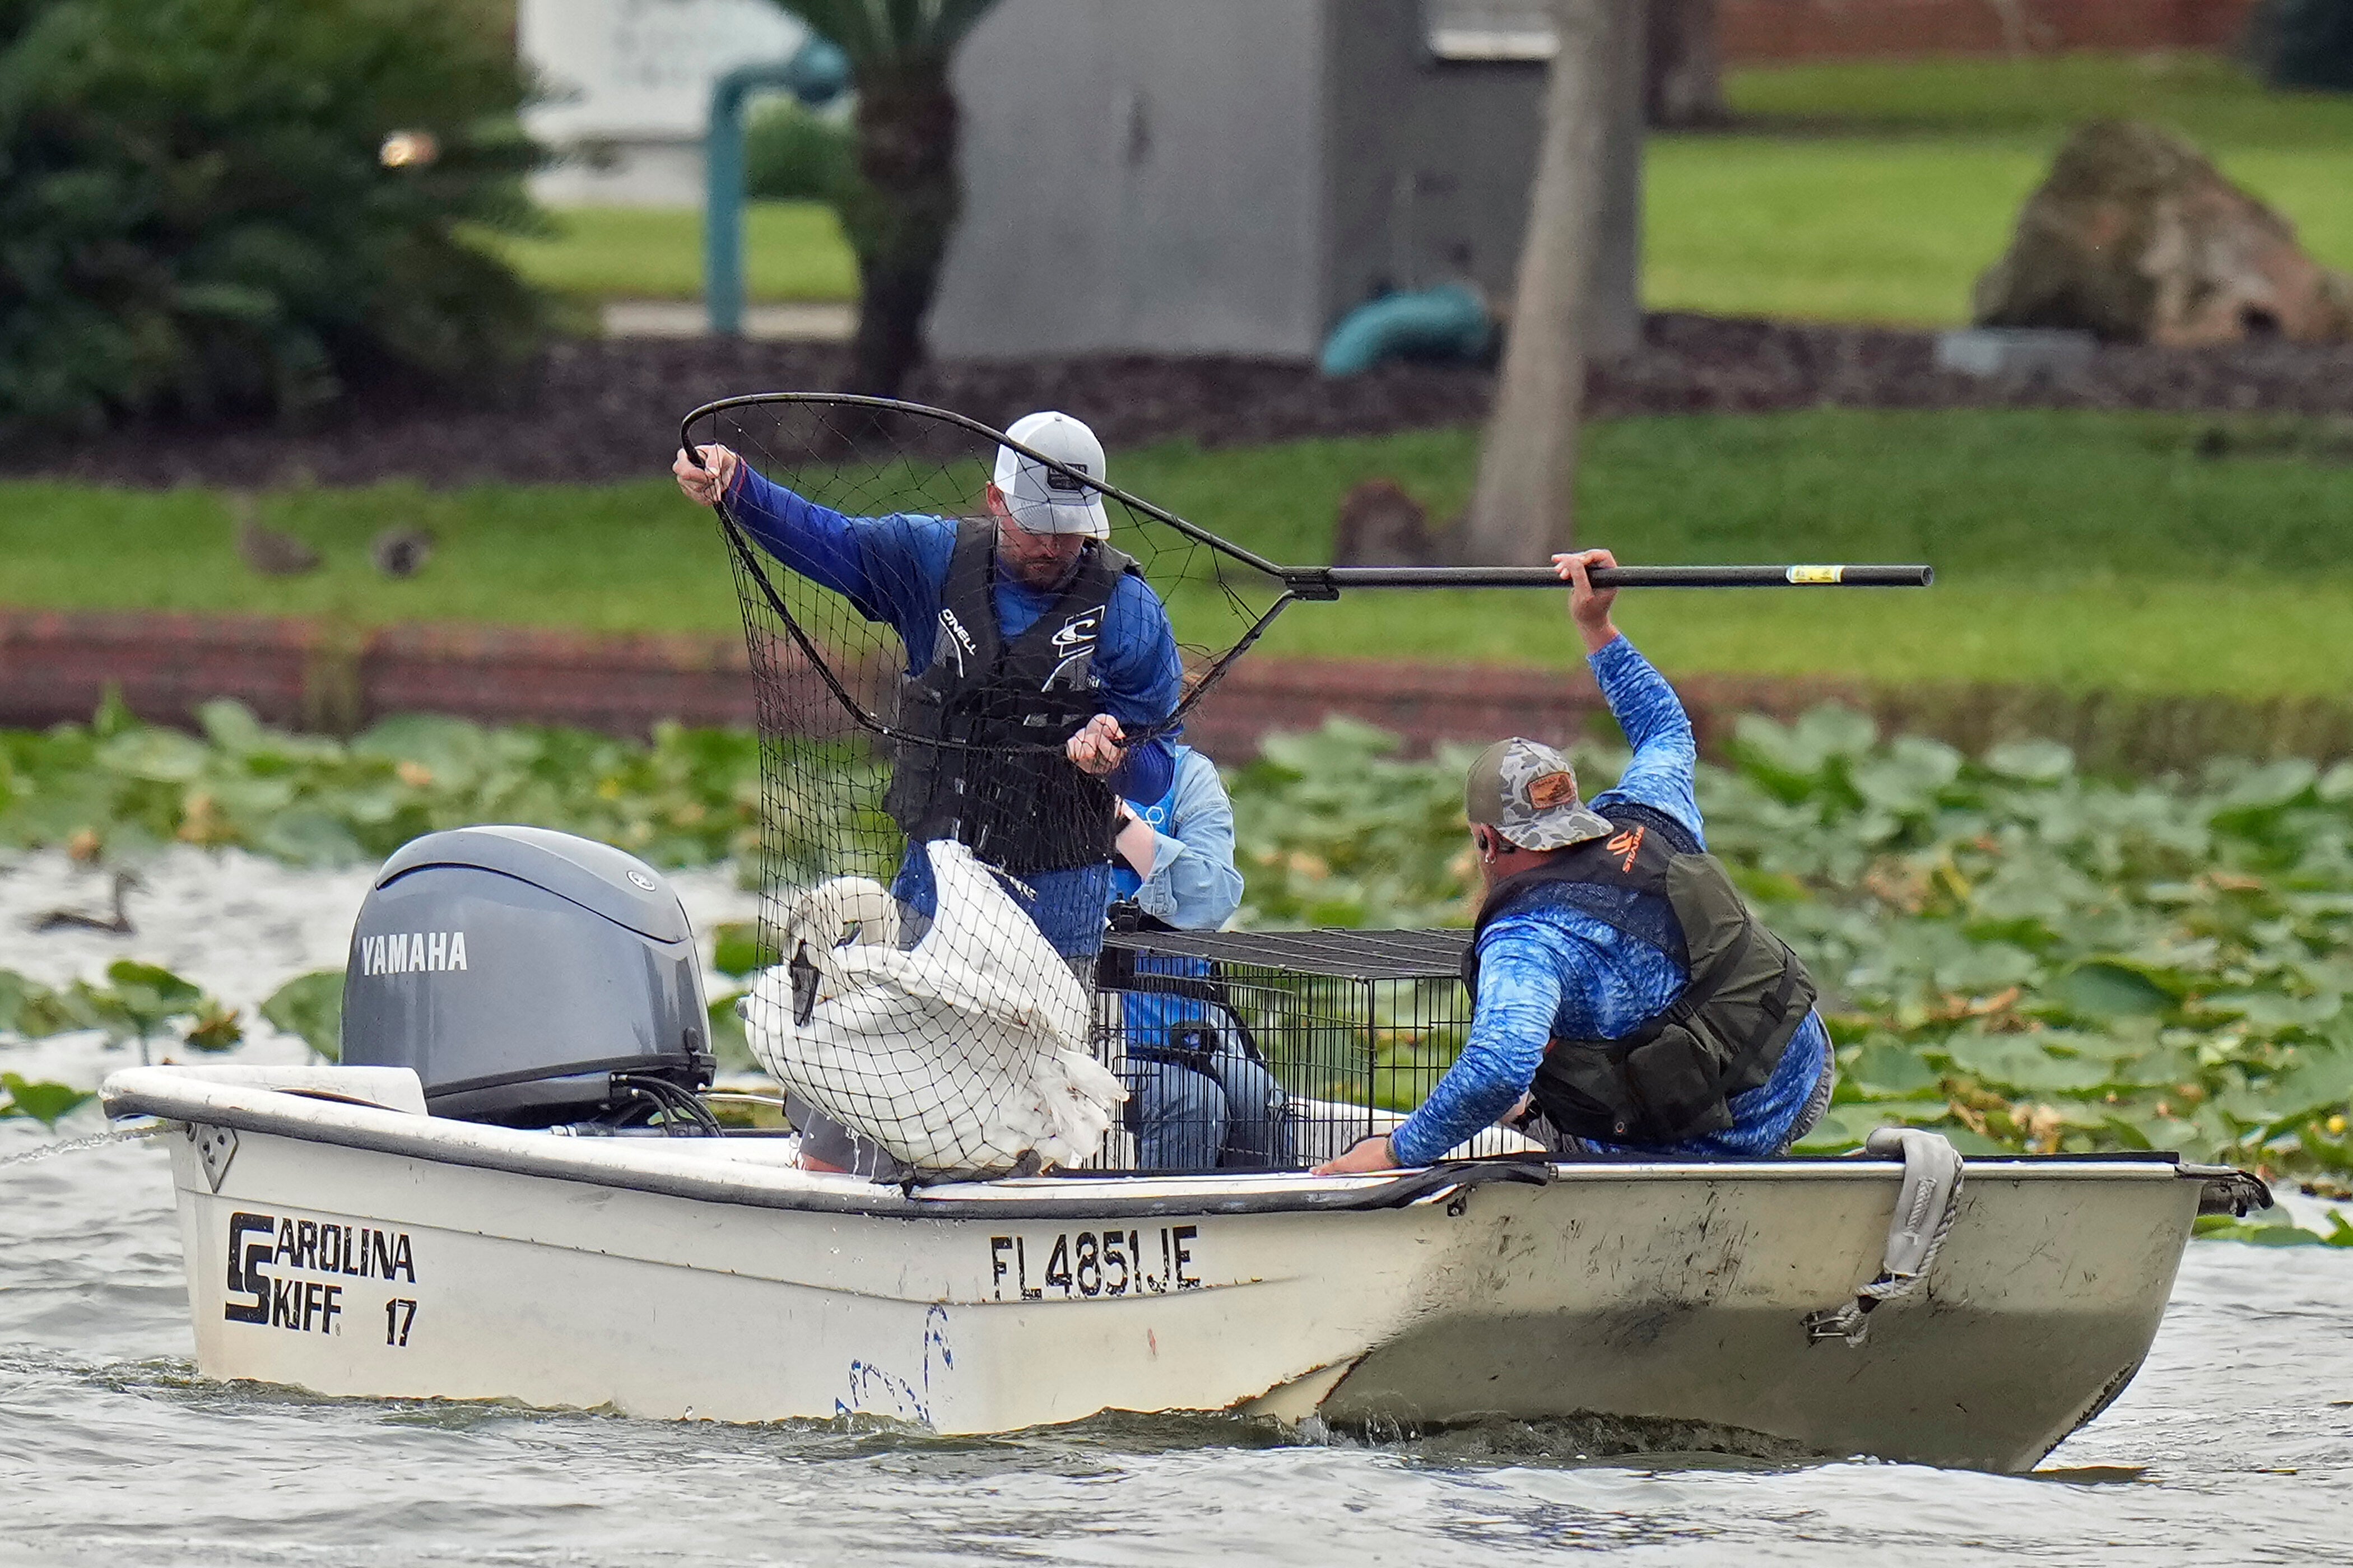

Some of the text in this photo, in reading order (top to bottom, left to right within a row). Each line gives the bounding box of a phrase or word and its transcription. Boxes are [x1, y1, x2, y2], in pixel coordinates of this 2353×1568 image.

[361, 932, 467, 975] YAMAHA
[227, 1212, 416, 1292] CAROLINA
[225, 1244, 417, 1347] SKIFF 17
